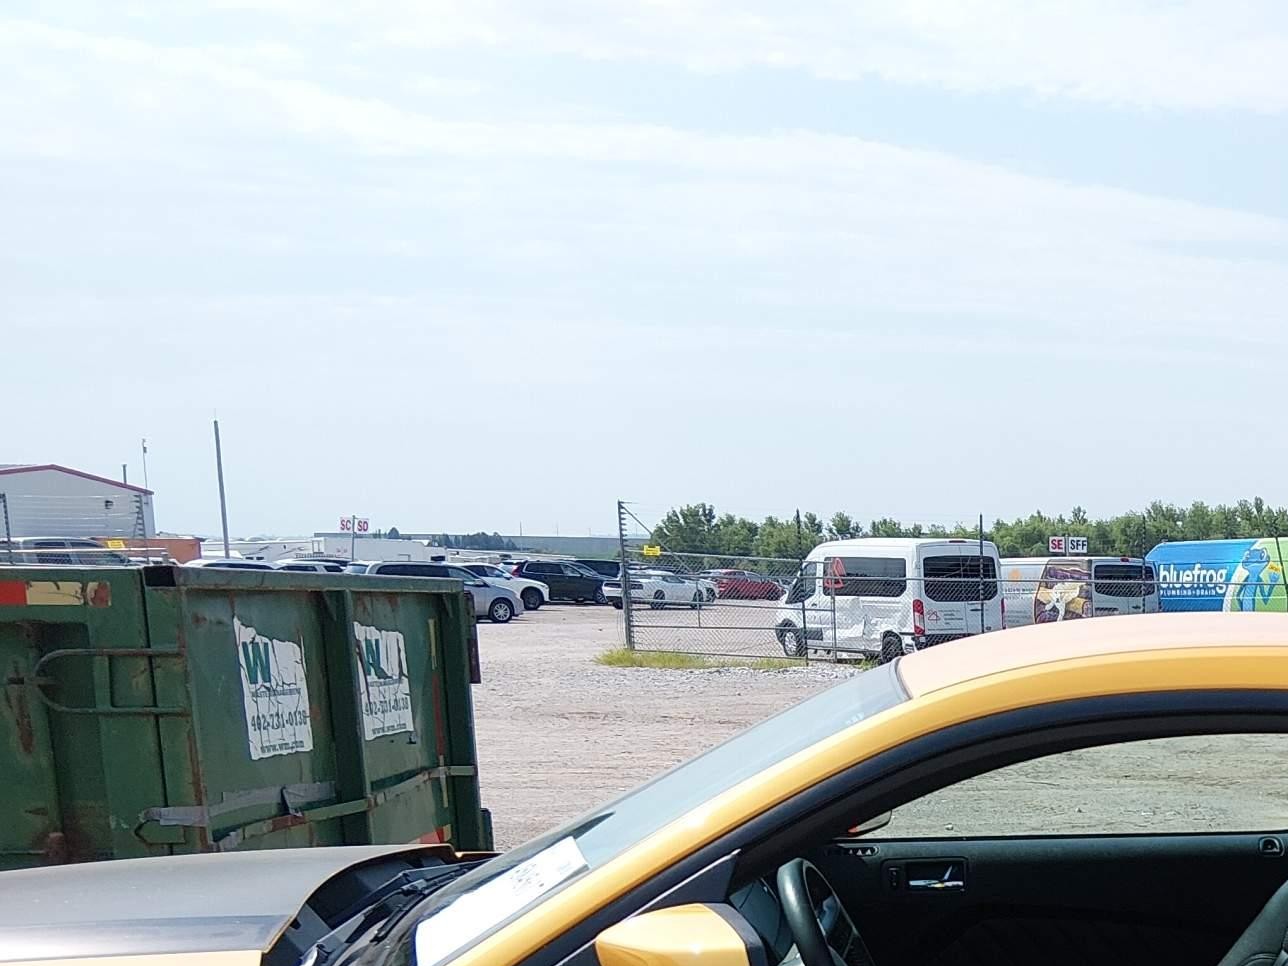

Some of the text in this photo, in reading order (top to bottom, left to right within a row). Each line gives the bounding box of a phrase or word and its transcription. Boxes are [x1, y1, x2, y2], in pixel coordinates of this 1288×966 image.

[340, 519, 352, 531] SC
[1050, 538, 1064, 550] SE
[1070, 539, 1087, 551] SFF
[1160, 563, 1228, 595] bluefrog
